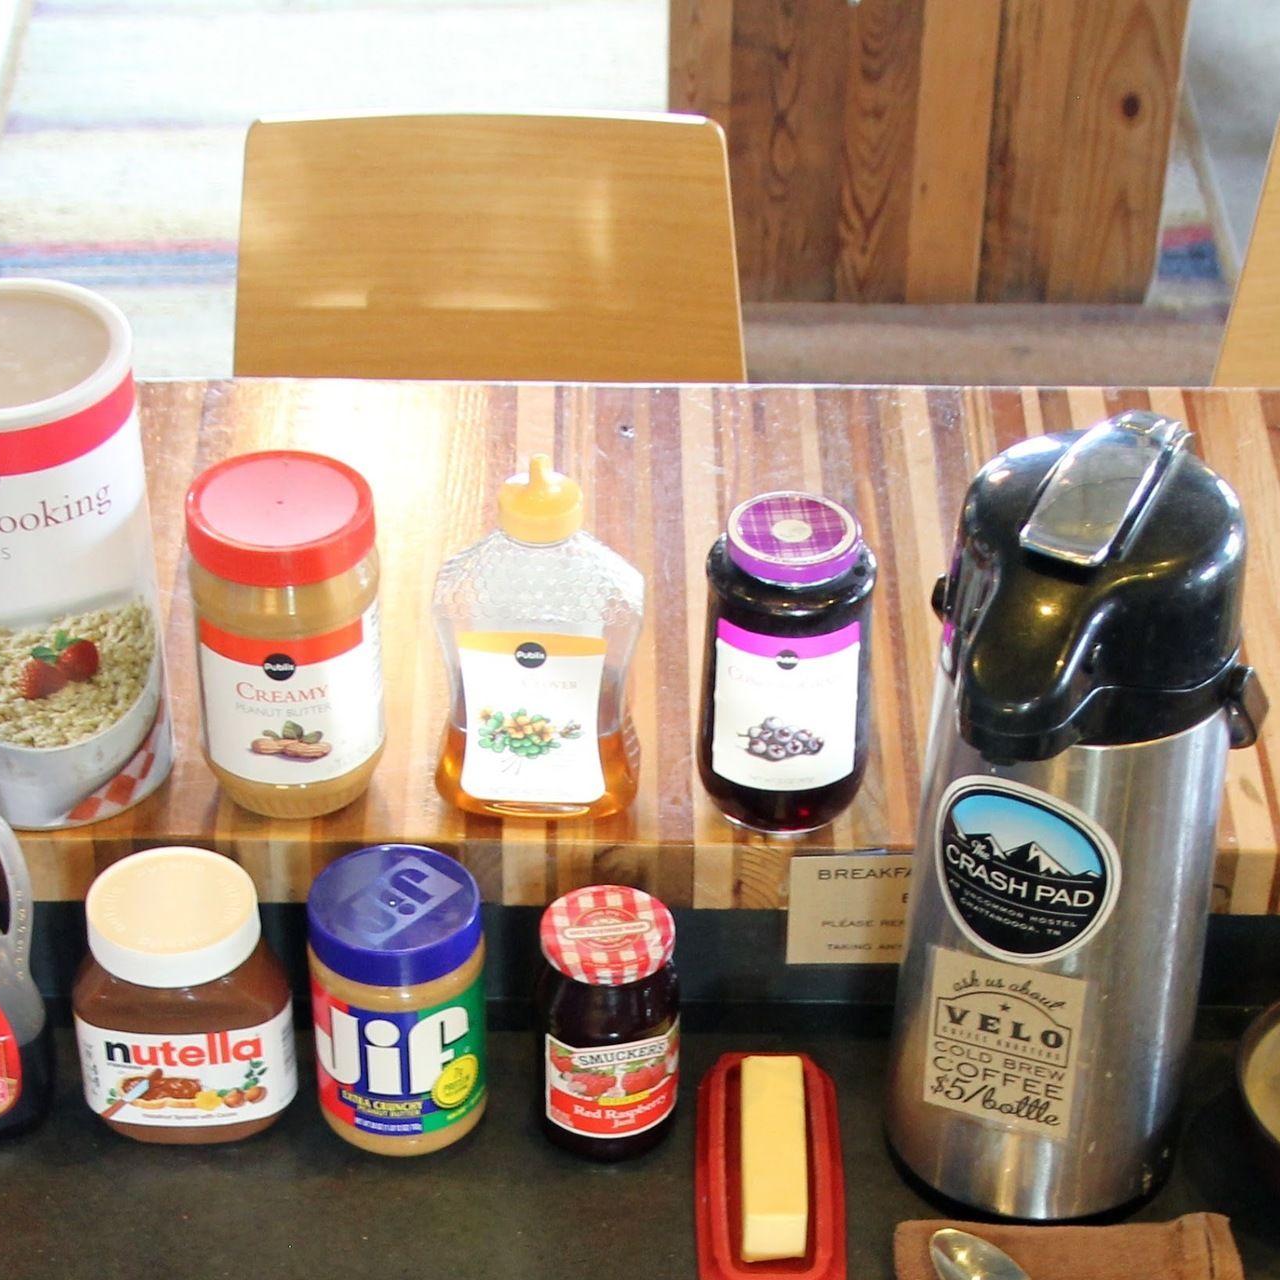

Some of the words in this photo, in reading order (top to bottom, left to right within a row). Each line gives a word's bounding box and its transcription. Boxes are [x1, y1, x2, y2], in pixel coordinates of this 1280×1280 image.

[235, 702, 282, 717] PEANUT
[286, 703, 332, 717] BUTTER
[970, 839, 991, 861] The
[945, 844, 1029, 899] CRASH
[1035, 885, 1095, 907] PAD
[821, 920, 874, 928] PLEASE
[963, 889, 1024, 918] UNCOMMON
[1029, 915, 1077, 928] HOSTEL
[1046, 928, 1062, 936] TN
[953, 969, 980, 991] ask
[985, 978, 1005, 988] us
[1008, 980, 1067, 1011] about
[945, 1005, 1064, 1048] VELO
[105, 1031, 263, 1067] nutella
[934, 1041, 992, 1064] COLD
[1003, 1058, 1065, 1081] BREW
[933, 1056, 1065, 1101] COFFEE
[573, 1104, 602, 1119] Red
[604, 1093, 668, 1121] Raspberry
[930, 1074, 1061, 1127] $5/bottle
